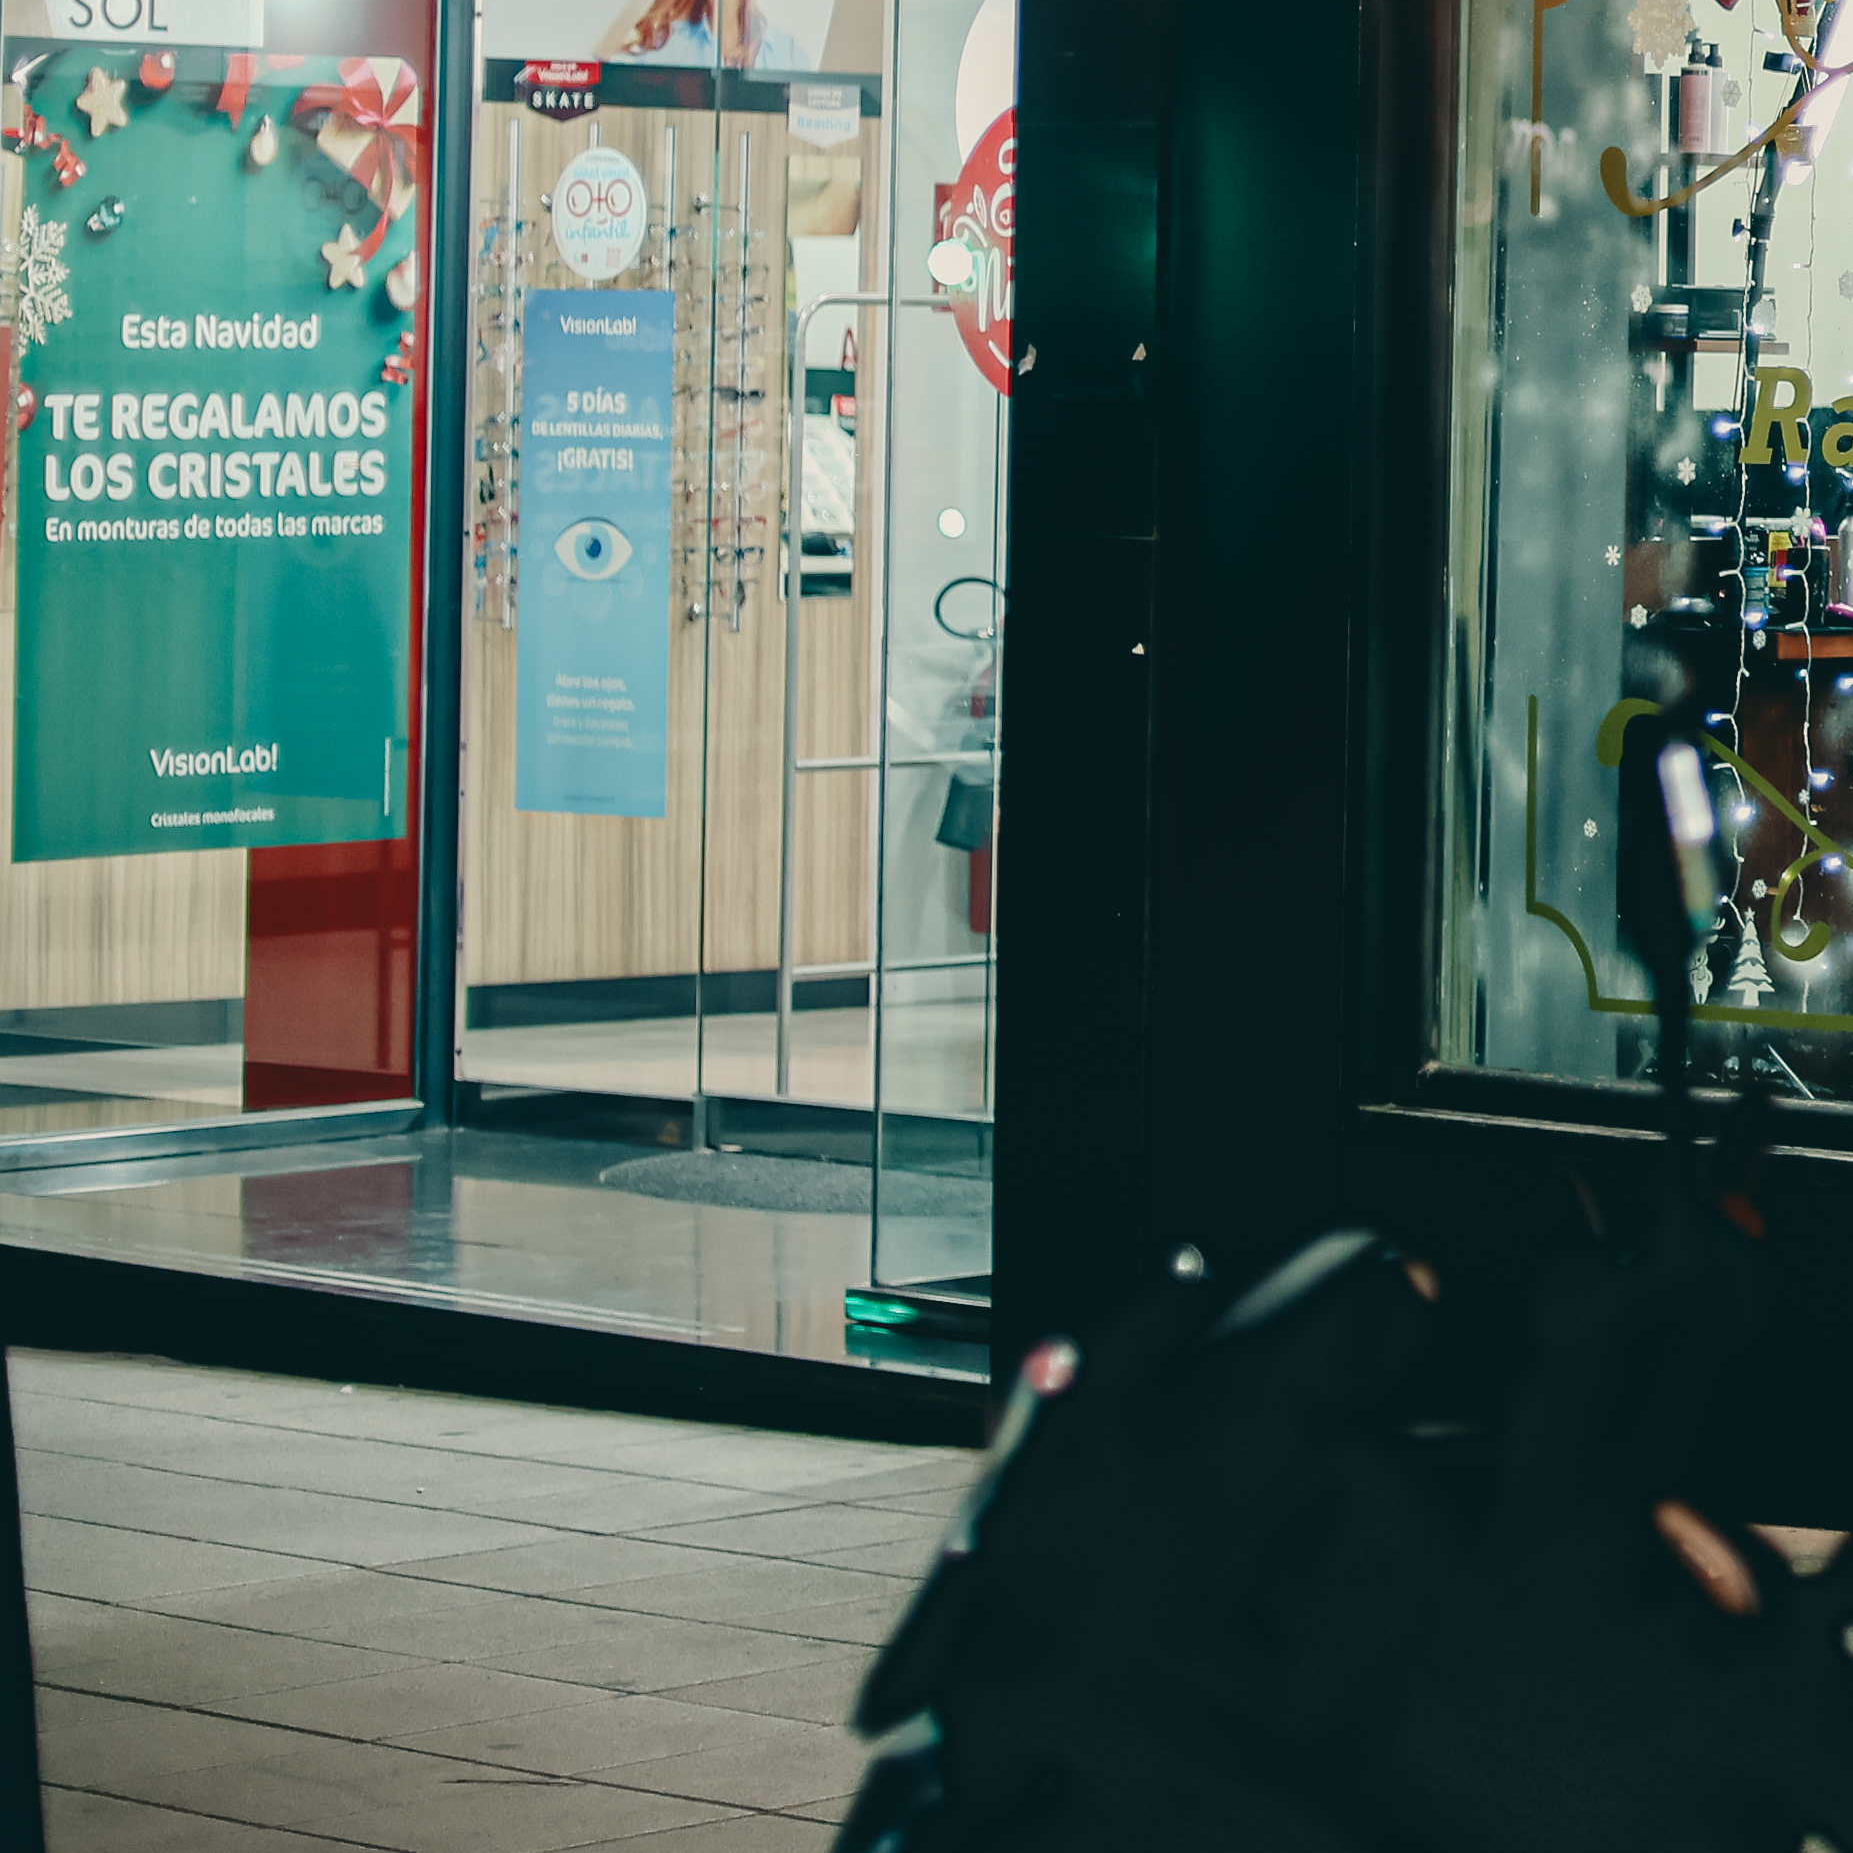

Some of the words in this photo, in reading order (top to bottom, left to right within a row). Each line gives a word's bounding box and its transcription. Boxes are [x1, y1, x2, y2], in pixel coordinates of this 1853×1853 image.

[532, 90, 594, 109] SKATE
[121, 313, 188, 349] Esta
[194, 312, 320, 349] Navidad
[560, 314, 637, 336] VisionLab!
[567, 389, 580, 414] 5
[582, 385, 628, 415] DÍAS
[45, 393, 100, 440] TE
[112, 391, 387, 441] REGALAMOS
[532, 420, 548, 436] DE
[550, 421, 611, 438] LENTILLAS
[44, 453, 134, 501] LOS
[148, 449, 386, 500] CRISTALES
[46, 516, 72, 542] En
[77, 517, 180, 542] monturas
[183, 513, 211, 539] de
[215, 513, 272, 539] todas
[277, 511, 307, 537] las
[311, 513, 384, 537] marcas
[150, 743, 279, 778] VisionLab!
[151, 810, 201, 828] Cristales
[202, 806, 276, 825] monofocales
